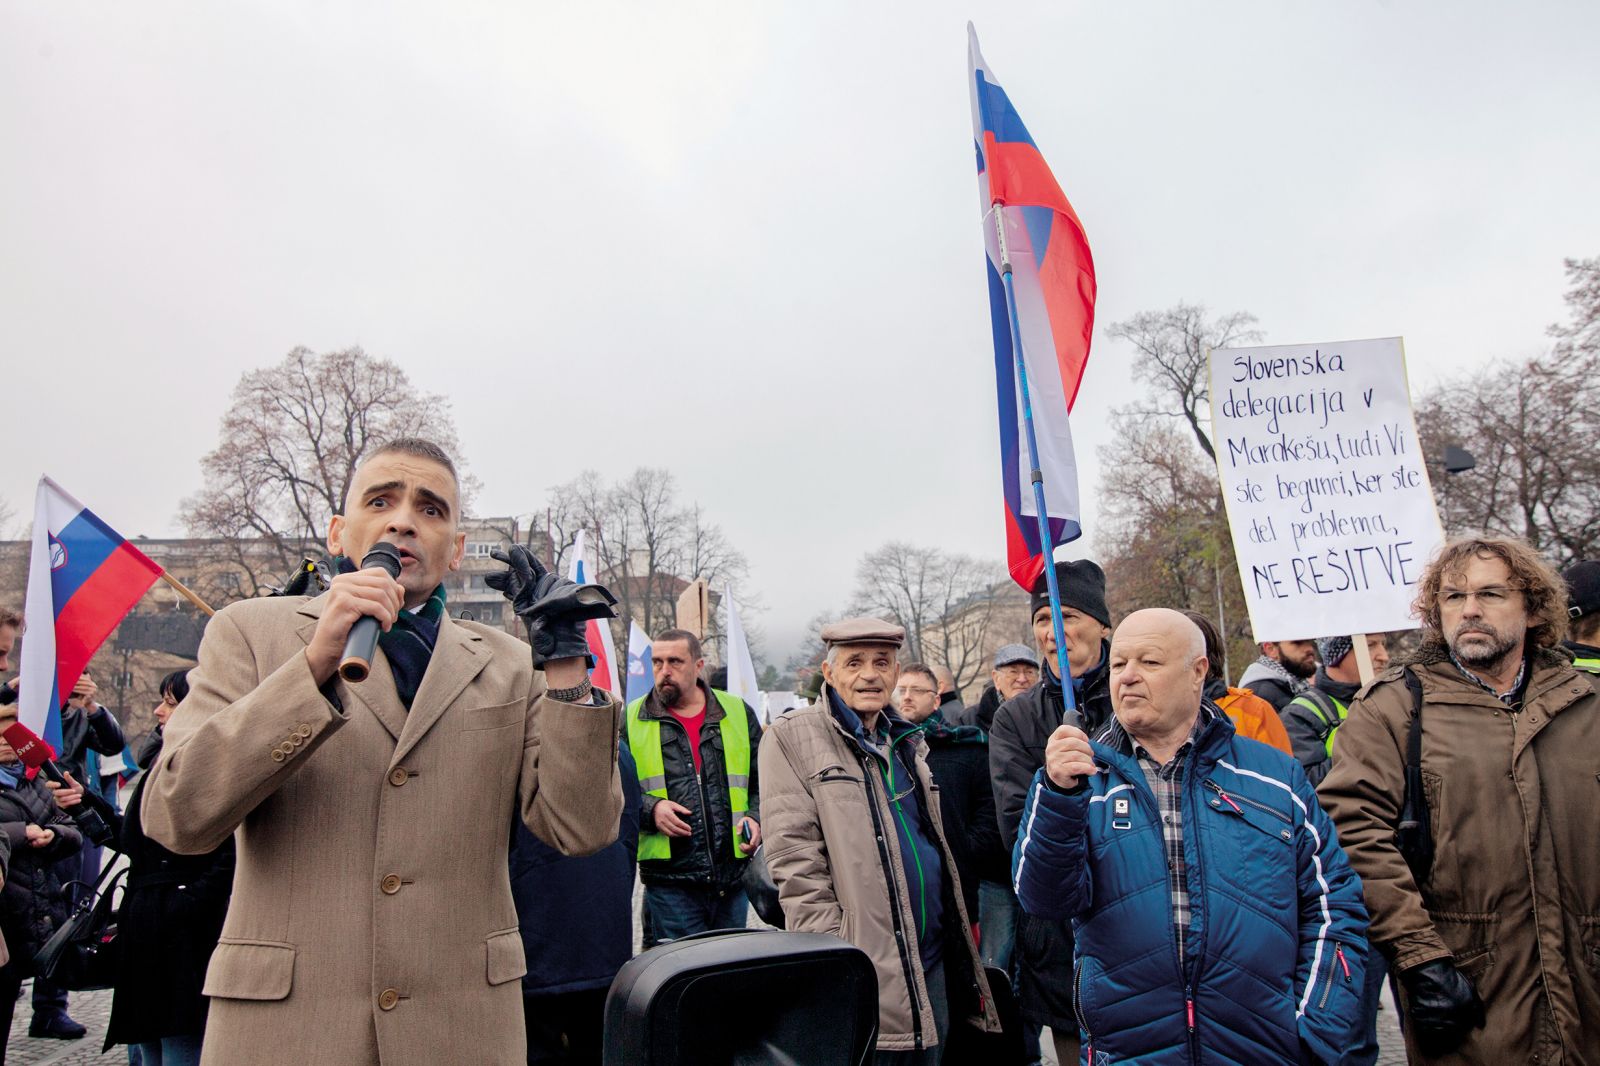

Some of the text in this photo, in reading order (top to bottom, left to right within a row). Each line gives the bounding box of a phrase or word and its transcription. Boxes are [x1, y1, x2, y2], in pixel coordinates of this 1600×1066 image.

[1232, 349, 1345, 382] Slovenska
[1222, 387, 1373, 434] delegacija v
[1227, 433, 1339, 468] Marakešu,
[1383, 423, 1405, 456] Vi
[1236, 465, 1420, 514] ste begunci, ker ste
[1249, 509, 1399, 552] del problema,
[1252, 541, 1418, 599] NE REŠITVE
[16, 740, 35, 756] Svet
